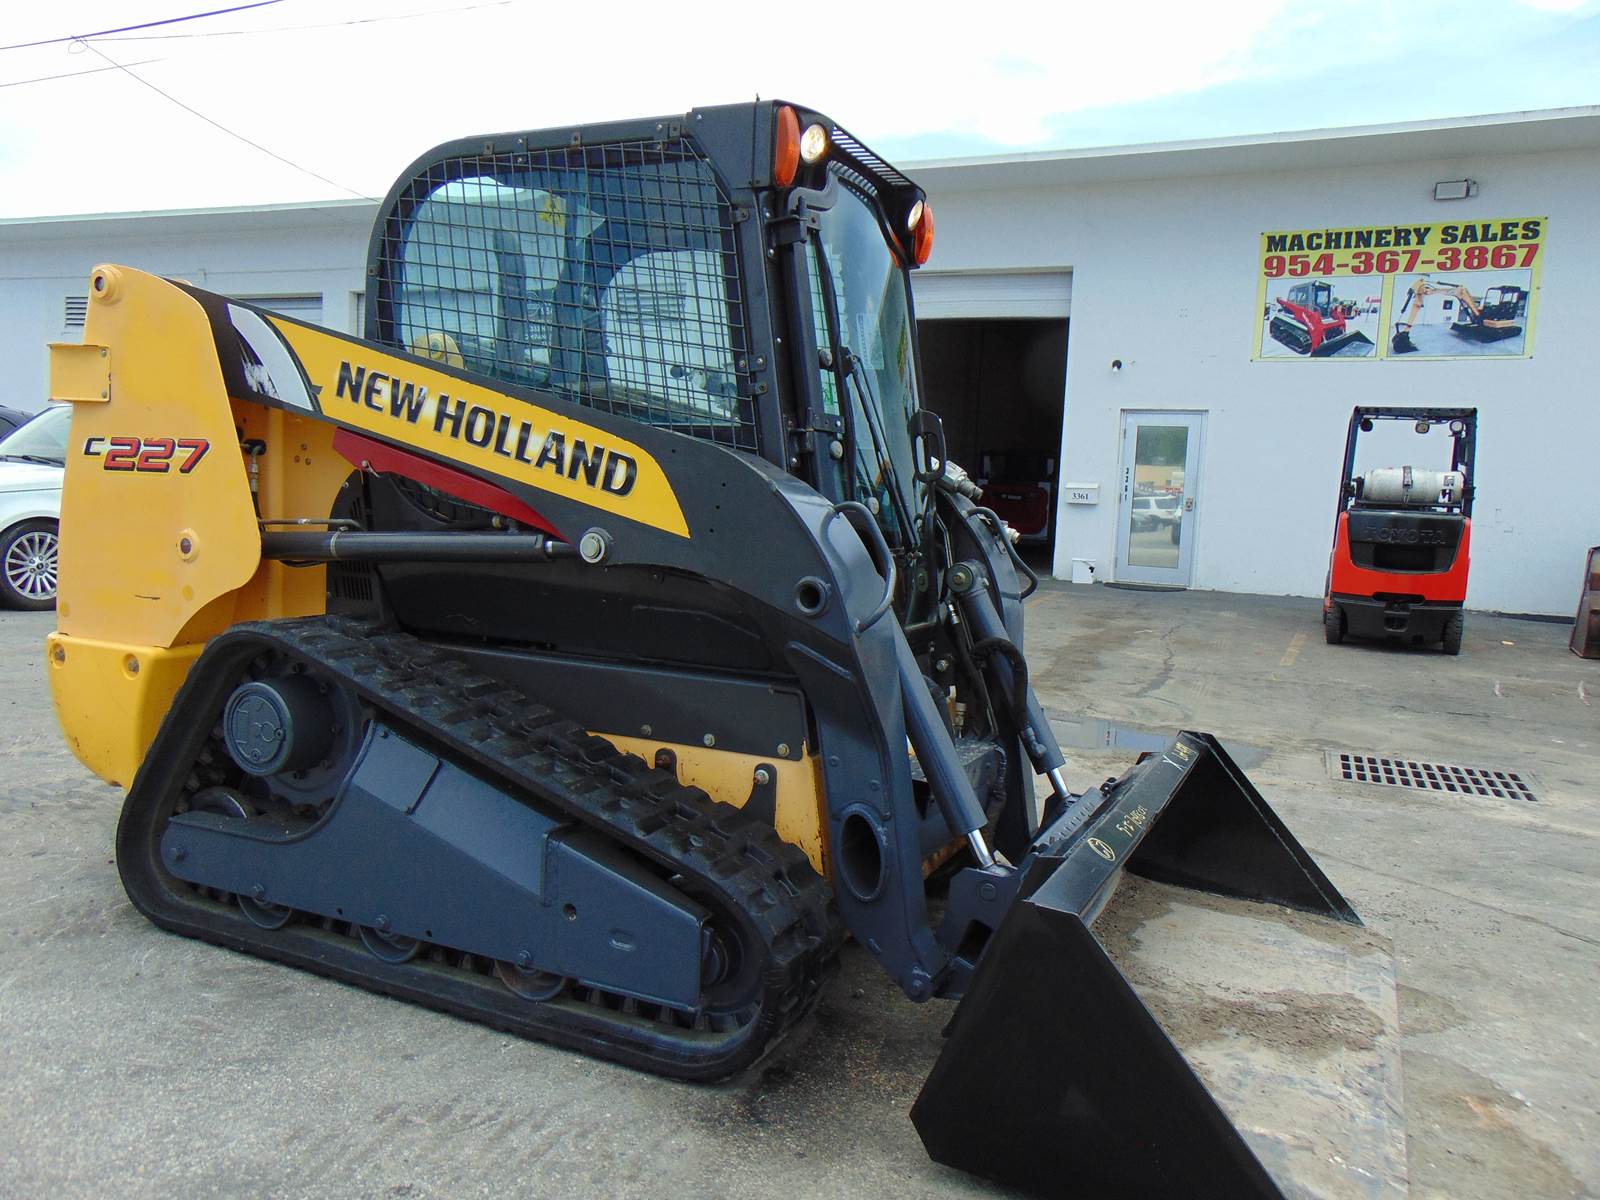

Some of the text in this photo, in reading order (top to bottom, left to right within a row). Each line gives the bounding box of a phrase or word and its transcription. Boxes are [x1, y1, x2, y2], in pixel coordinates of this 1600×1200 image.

[1266, 220, 1541, 253] MACHINERY SALES
[1264, 243, 1539, 278] 954-367-3867
[335, 361, 638, 498] NEW HOLLAND
[1072, 492, 1089, 500] 3361
[1365, 526, 1447, 545] TOYOTA
